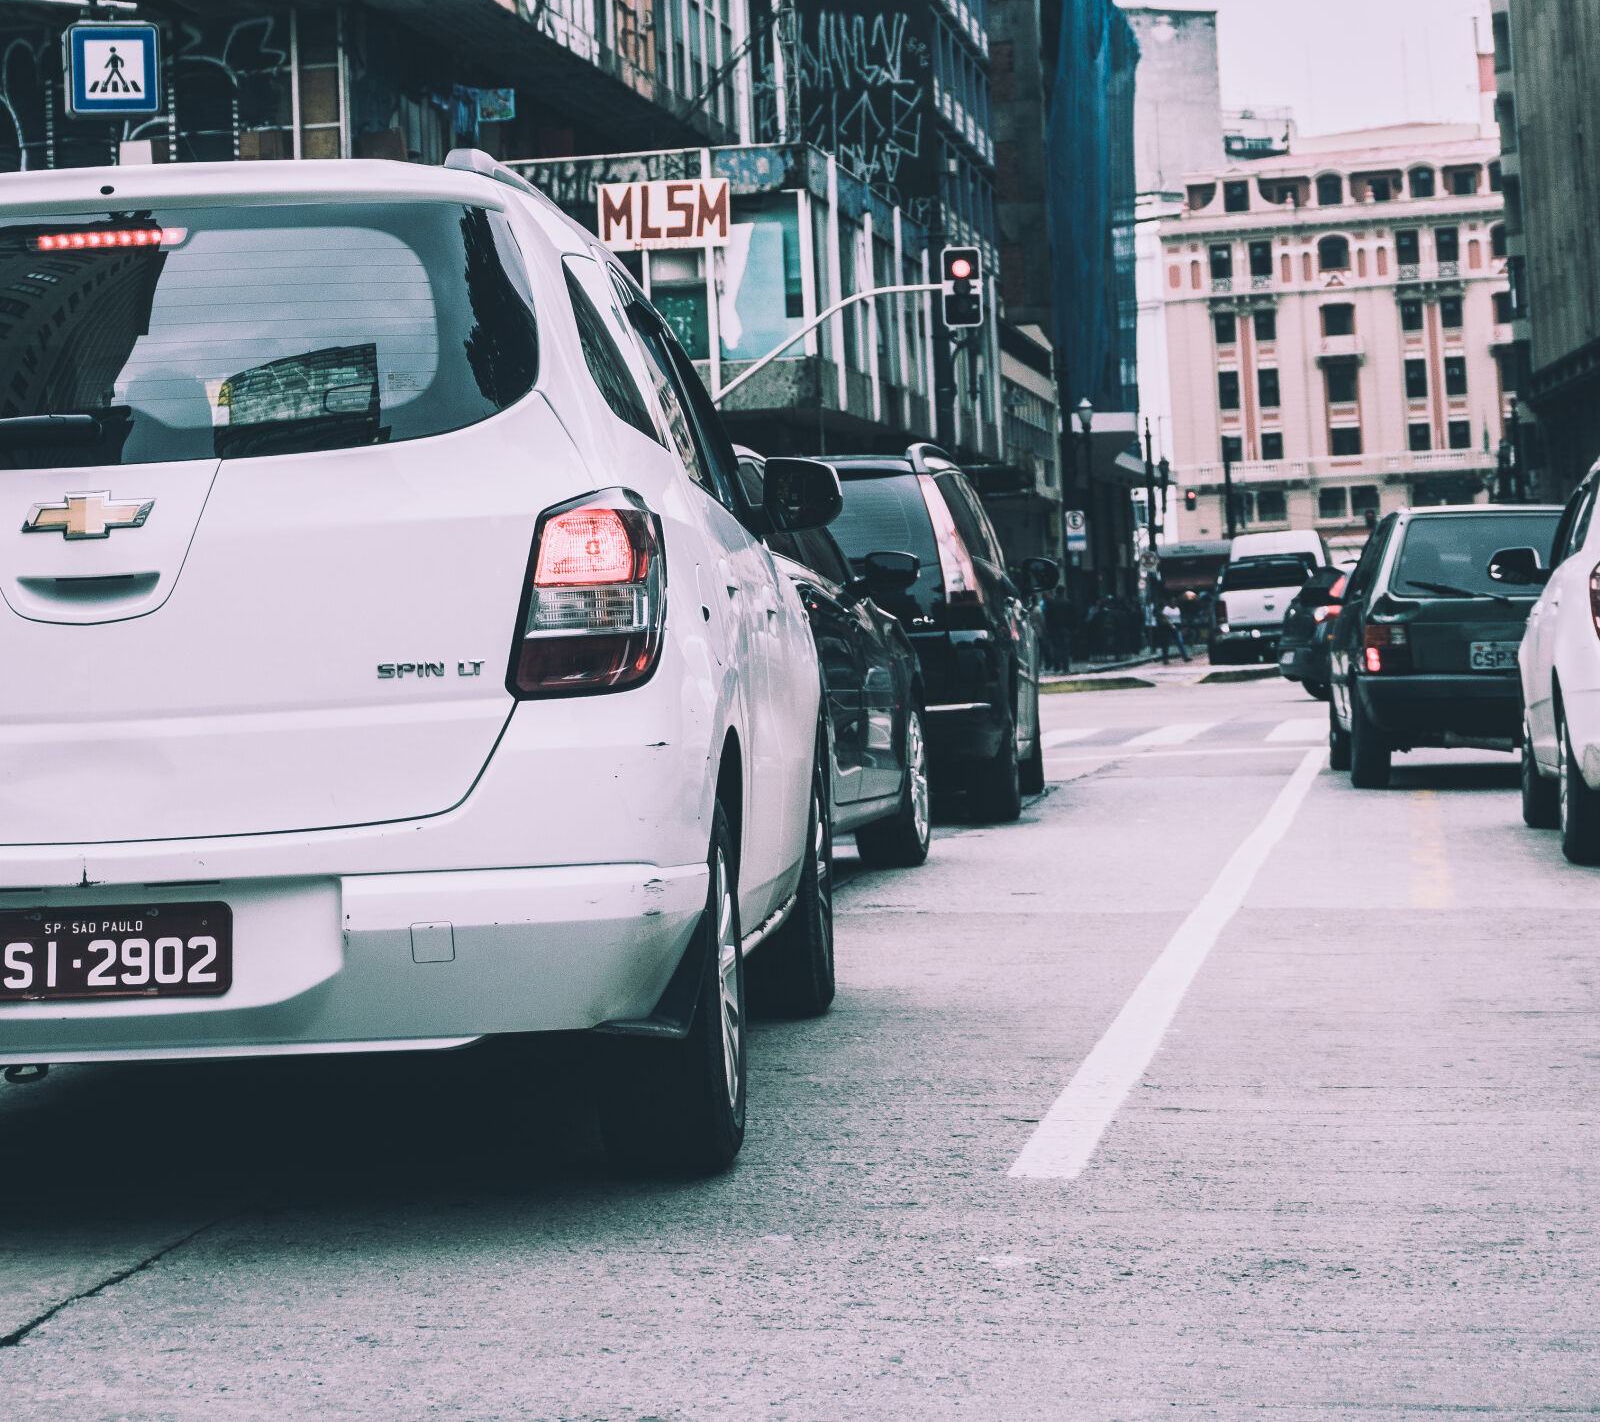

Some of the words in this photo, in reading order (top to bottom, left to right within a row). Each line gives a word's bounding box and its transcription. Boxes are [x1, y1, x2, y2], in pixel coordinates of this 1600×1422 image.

[601, 181, 728, 242] MLSM
[377, 661, 445, 679] SPIN
[458, 659, 486, 677] LT
[102, 920, 143, 932] PAULO
